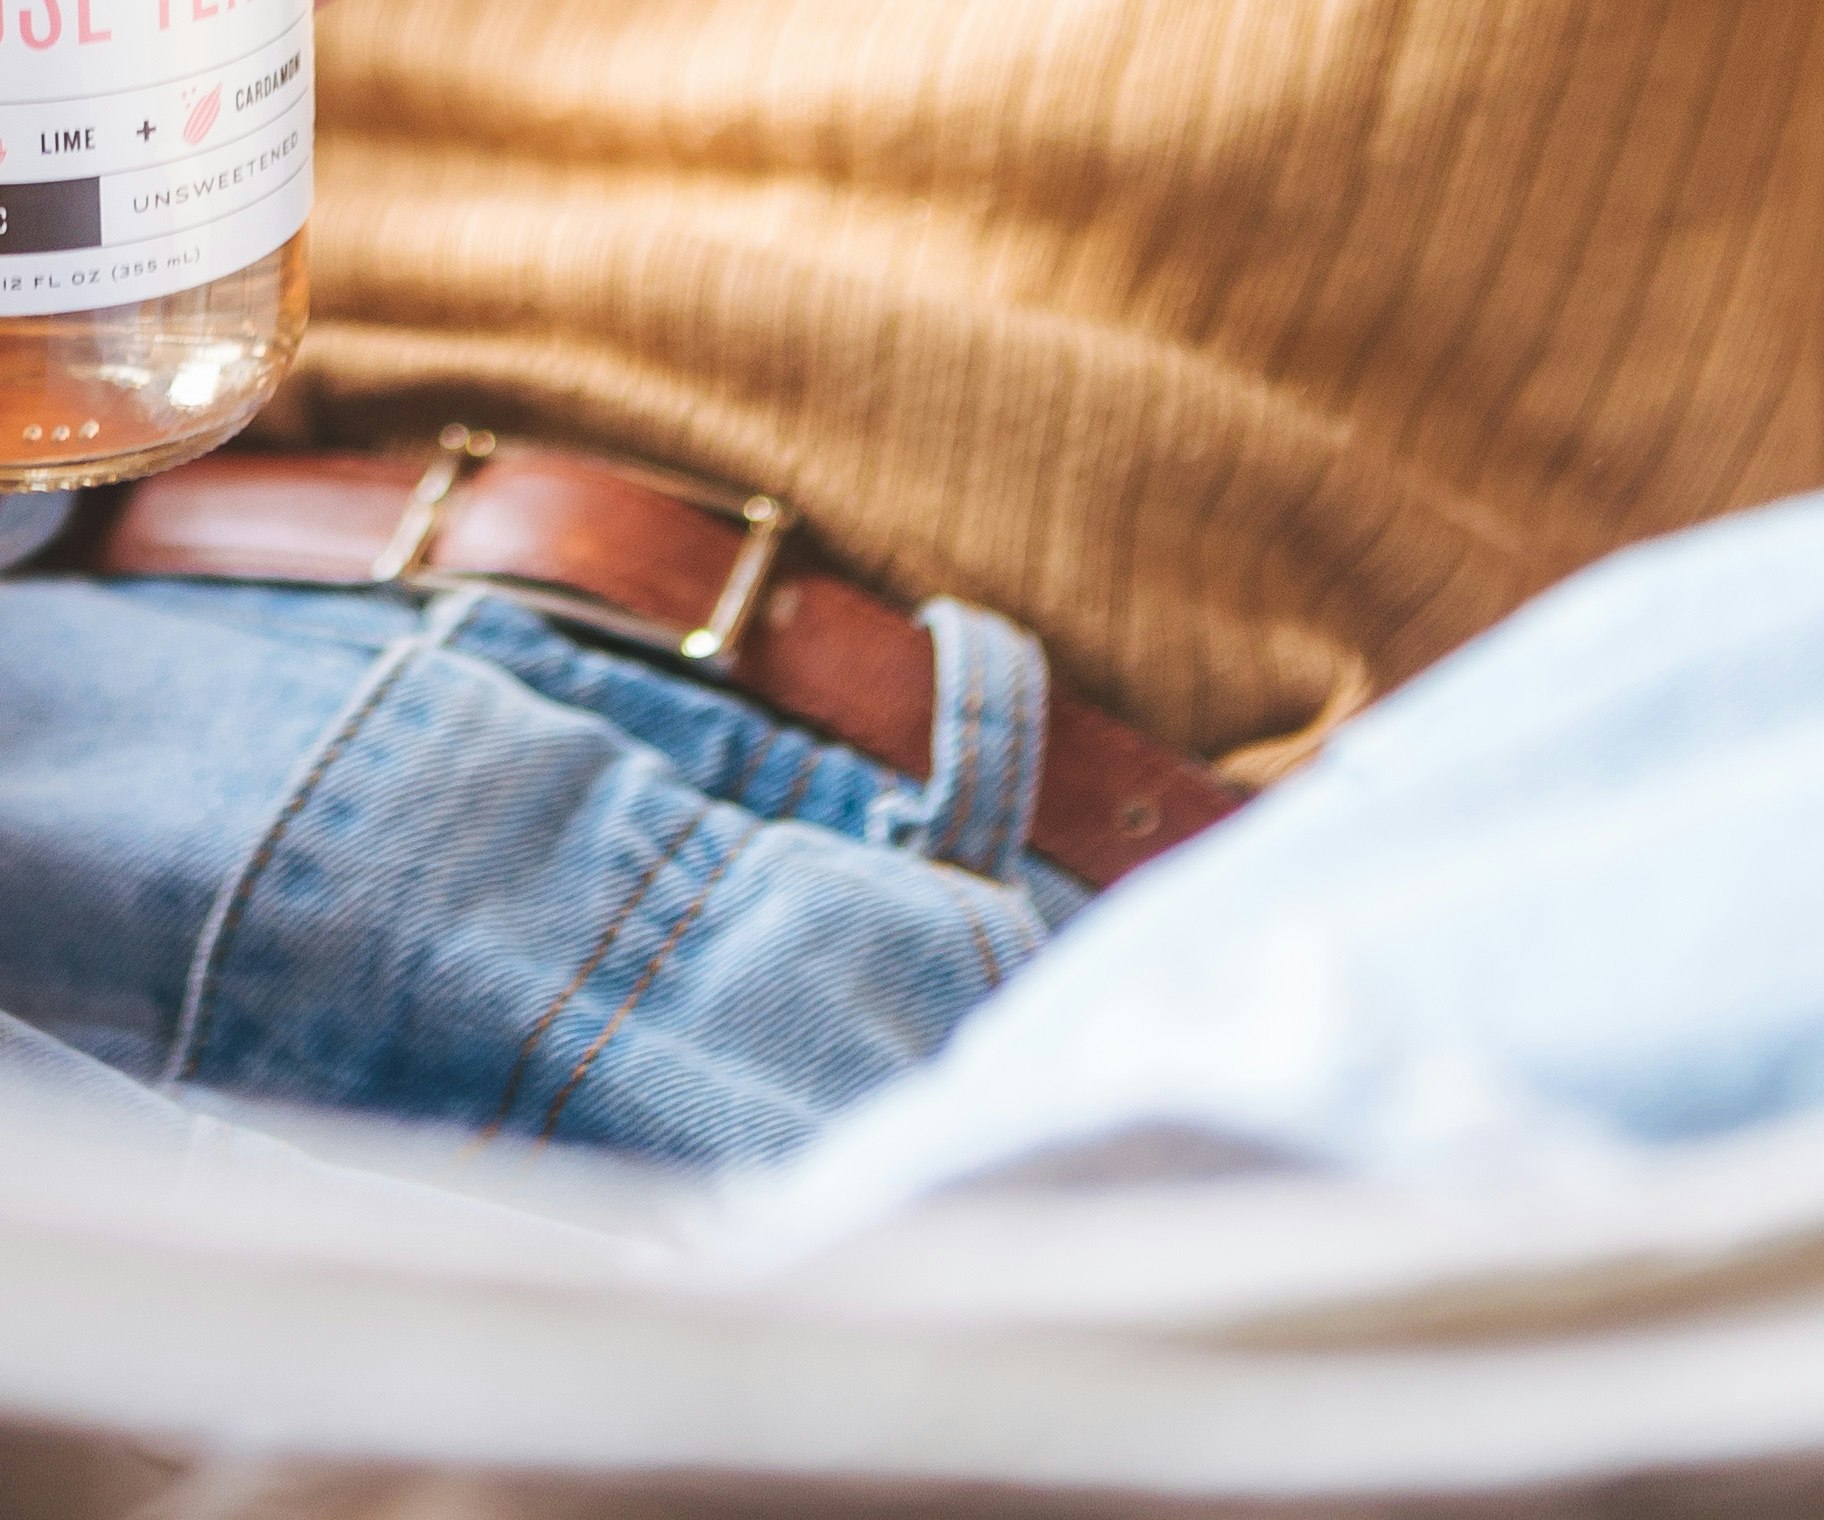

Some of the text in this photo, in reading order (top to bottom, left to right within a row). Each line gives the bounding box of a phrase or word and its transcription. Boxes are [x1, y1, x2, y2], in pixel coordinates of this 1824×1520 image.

[41, 127, 96, 154] LIME
[133, 131, 299, 214] UNSWEETENED
[2, 277, 22, 292] 12
[34, 276, 61, 289] FL
[71, 269, 100, 287] OZ
